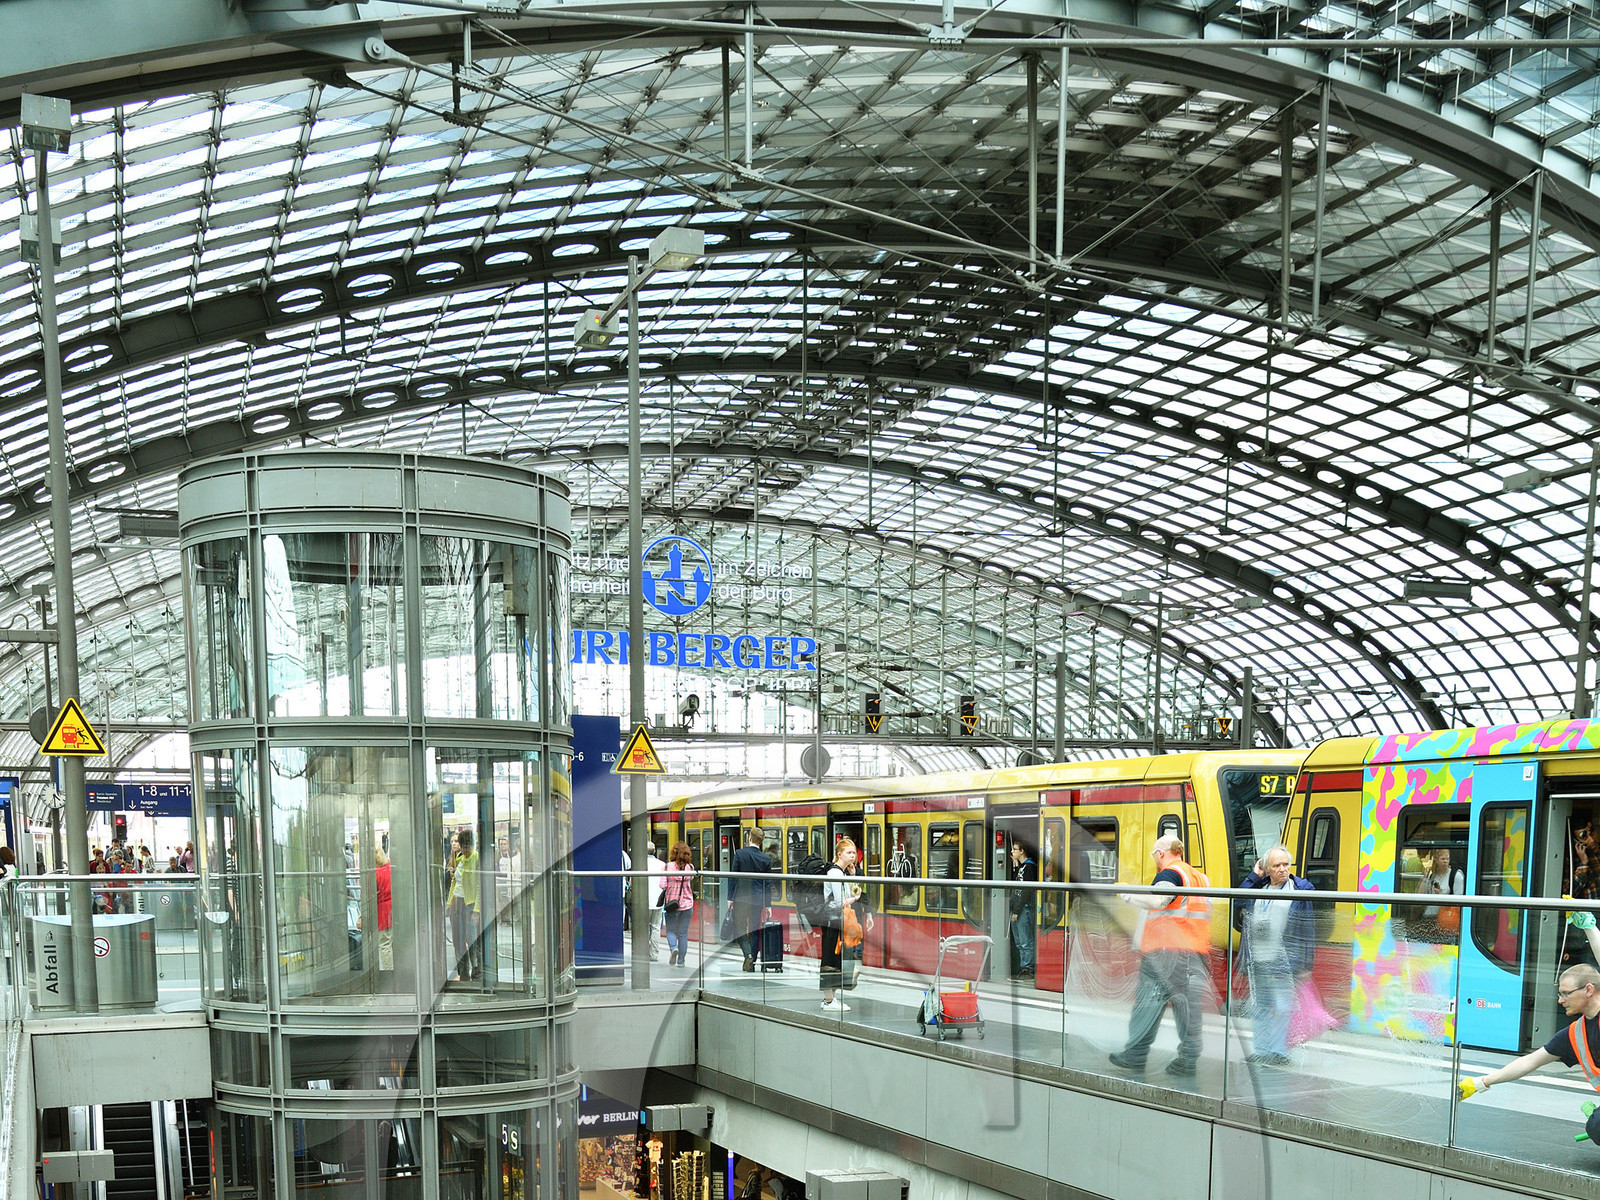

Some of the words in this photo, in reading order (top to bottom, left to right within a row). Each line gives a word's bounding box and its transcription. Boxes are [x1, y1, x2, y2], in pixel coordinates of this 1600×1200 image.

[718, 559, 739, 576] im
[744, 559, 813, 579] Zeichen
[718, 583, 749, 600] der
[753, 584, 793, 605] Burg
[139, 786, 158, 797] 1-8
[1260, 775, 1279, 794] S7
[140, 799, 158, 807] Ausgang
[43, 944, 59, 995] Abfall
[603, 1110, 639, 1123] BERLIN
[502, 1123, 509, 1146] 5
[510, 1130, 519, 1150] S
